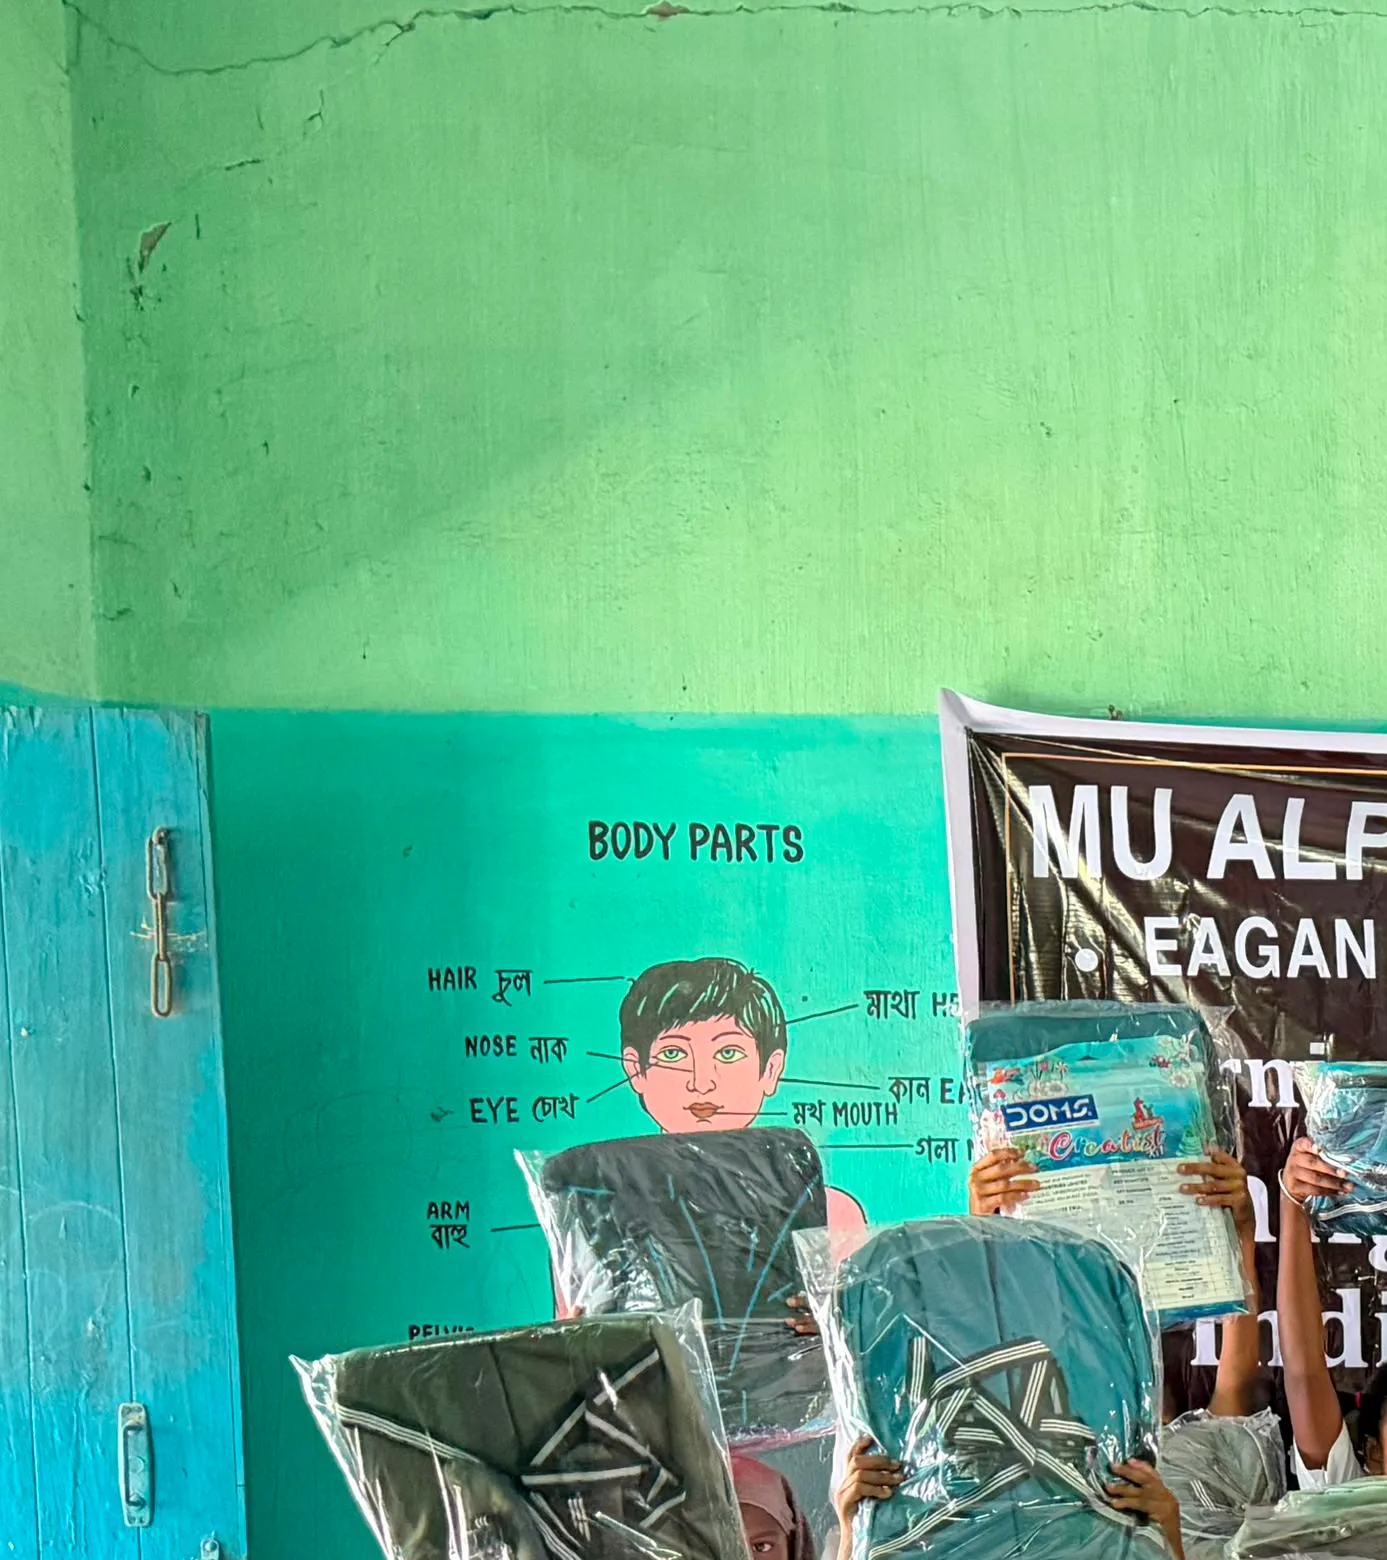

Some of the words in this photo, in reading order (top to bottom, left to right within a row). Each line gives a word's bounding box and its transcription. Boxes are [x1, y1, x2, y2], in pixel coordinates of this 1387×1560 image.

[589, 821, 677, 860] BODY
[689, 823, 804, 863] PARTS
[1028, 784, 1173, 881] MU
[1143, 916, 1377, 980] EAGAN
[428, 966, 477, 991] HAIR
[492, 969, 534, 1007] চুল
[864, 989, 920, 1019] মাথা
[465, 1035, 517, 1057] NOSE
[529, 1037, 569, 1064] নাক
[888, 1076, 931, 1104] কান
[469, 1096, 520, 1124] EYE
[531, 1093, 580, 1123] চোখ
[832, 1100, 898, 1128] MOUTH
[916, 1135, 959, 1163] গলা
[427, 1200, 470, 1222] ARM
